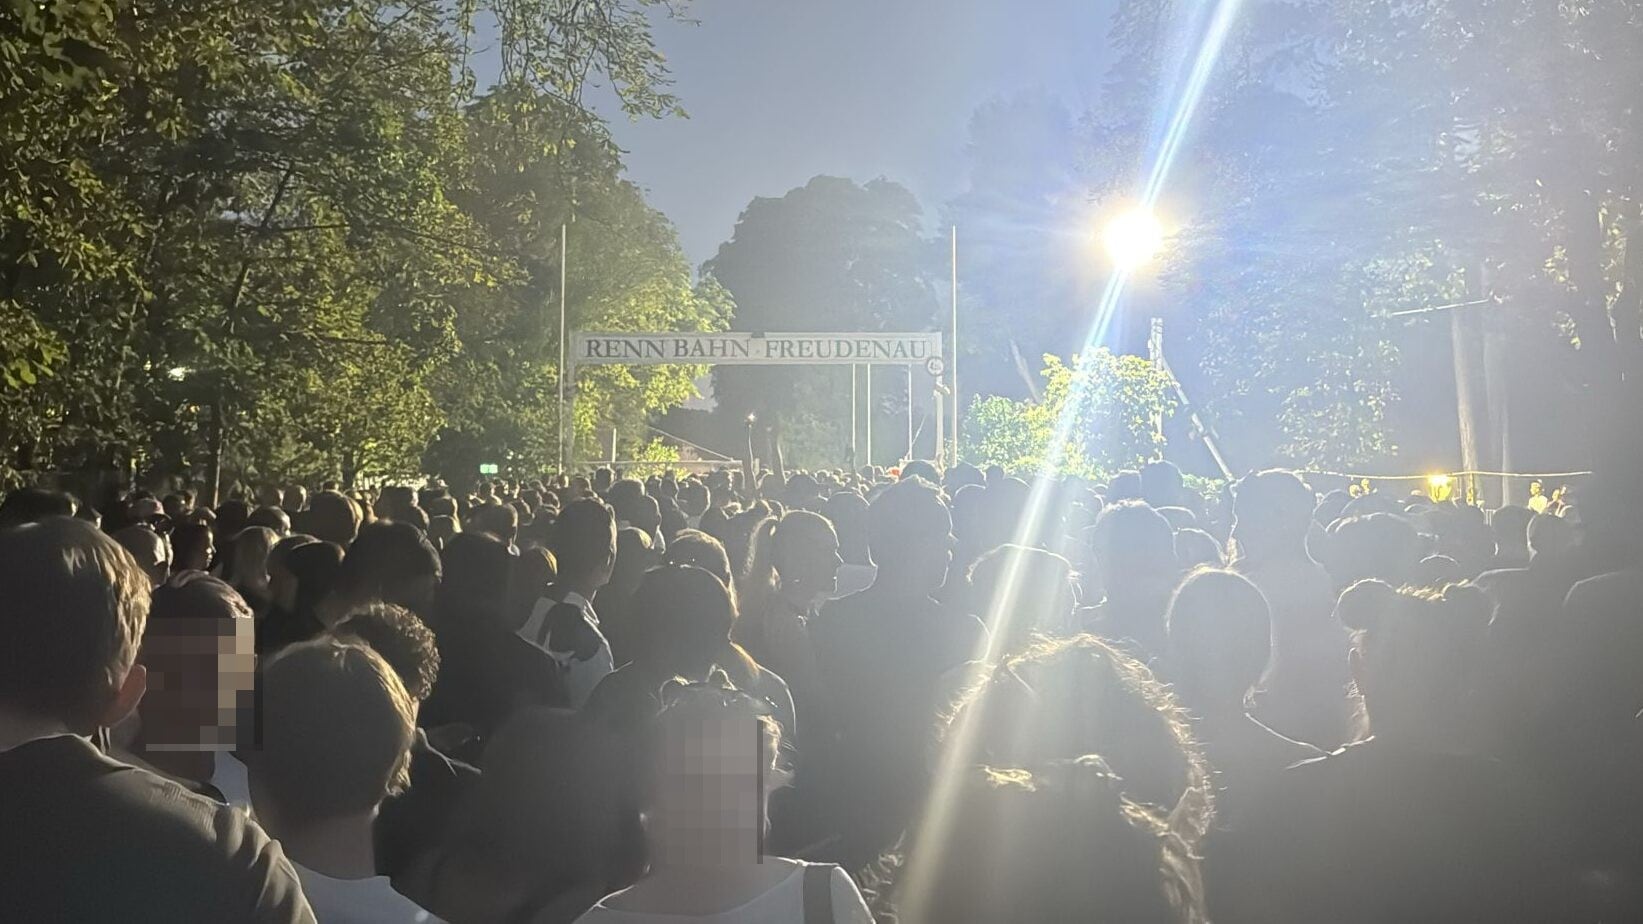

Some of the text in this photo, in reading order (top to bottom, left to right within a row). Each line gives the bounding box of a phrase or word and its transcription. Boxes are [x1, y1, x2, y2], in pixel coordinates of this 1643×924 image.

[585, 338, 927, 359] RENN BAHN FREUDENAU
